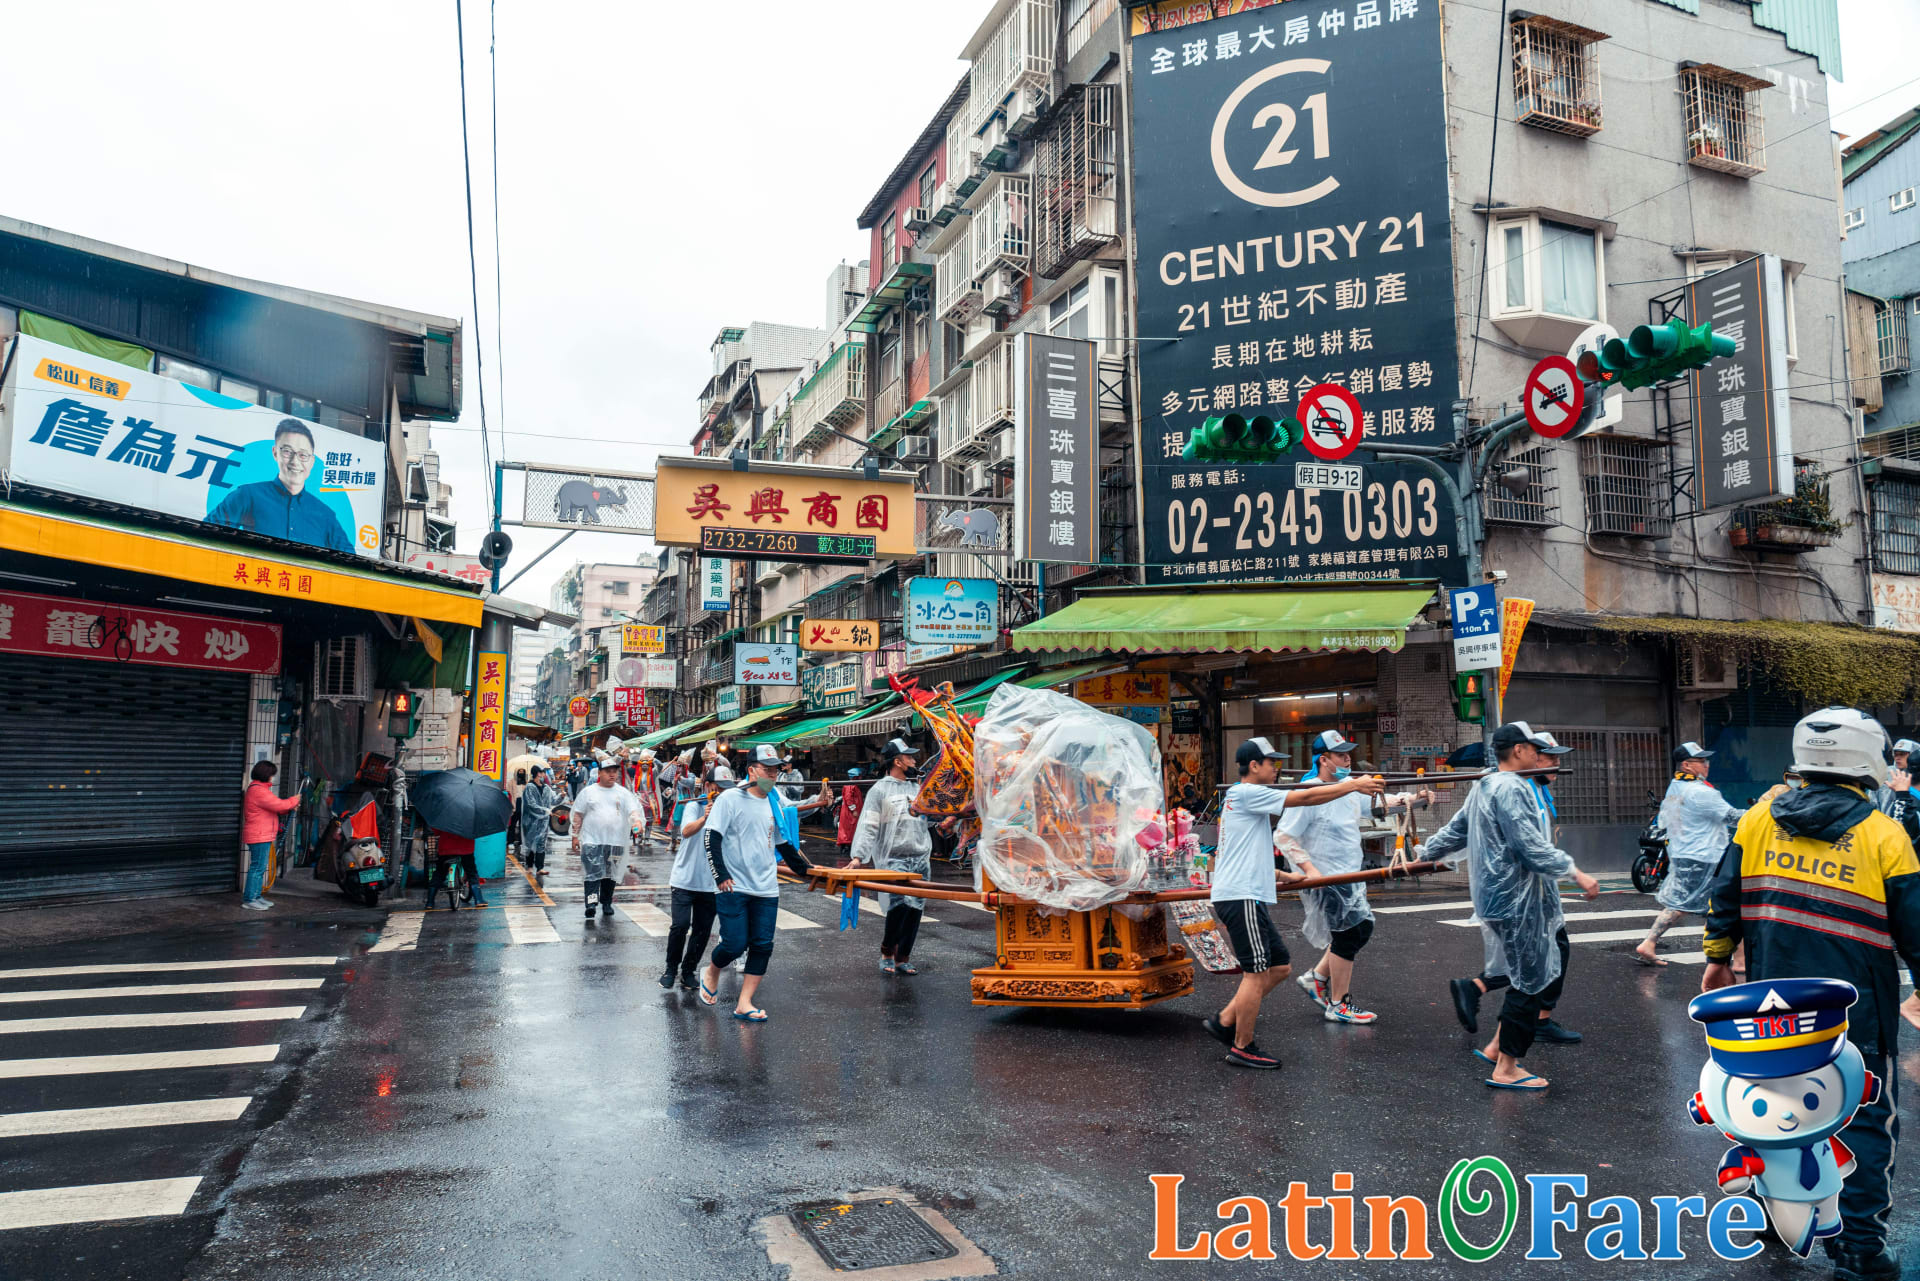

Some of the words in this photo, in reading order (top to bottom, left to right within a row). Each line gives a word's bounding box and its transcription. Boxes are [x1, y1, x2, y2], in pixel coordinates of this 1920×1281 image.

[1150, 0, 1419, 75] 全球最大房仲品牌
[1251, 92, 1330, 170] 21
[1159, 221, 1367, 286] CENTURY
[1378, 212, 1424, 254] 21
[1177, 272, 1408, 331] 21世紀不動產
[1212, 327, 1374, 370] 長期在地耕耘
[1712, 282, 1752, 490] 三喜珠寶銀樓
[29, 397, 246, 488] 詹為元
[1046, 352, 1077, 546] 三喜珠寶銀樓
[324, 469, 376, 485] 吳興市場
[1171, 468, 1246, 489] 服務電話:
[1299, 466, 1359, 487] 假日9-12
[686, 483, 890, 532] 吳興商圈
[1167, 488, 1323, 554] 02-2345
[1342, 478, 1438, 542] 0303
[361, 527, 376, 546] 元
[704, 530, 798, 551] 2732-7260
[817, 535, 874, 556] 歡迎光
[1162, 555, 1300, 577] 台北市信義區松仁路211號
[1308, 544, 1449, 567] 家樂福資產管理有限公司
[233, 563, 312, 595] 吳興商圈
[916, 600, 991, 623] 冰山一角
[1455, 591, 1479, 623] P
[1460, 625, 1482, 634] 110m
[478, 661, 501, 773] 吳興商圈
[1380, 720, 1395, 731] 158
[1764, 850, 1857, 884] POLICE
